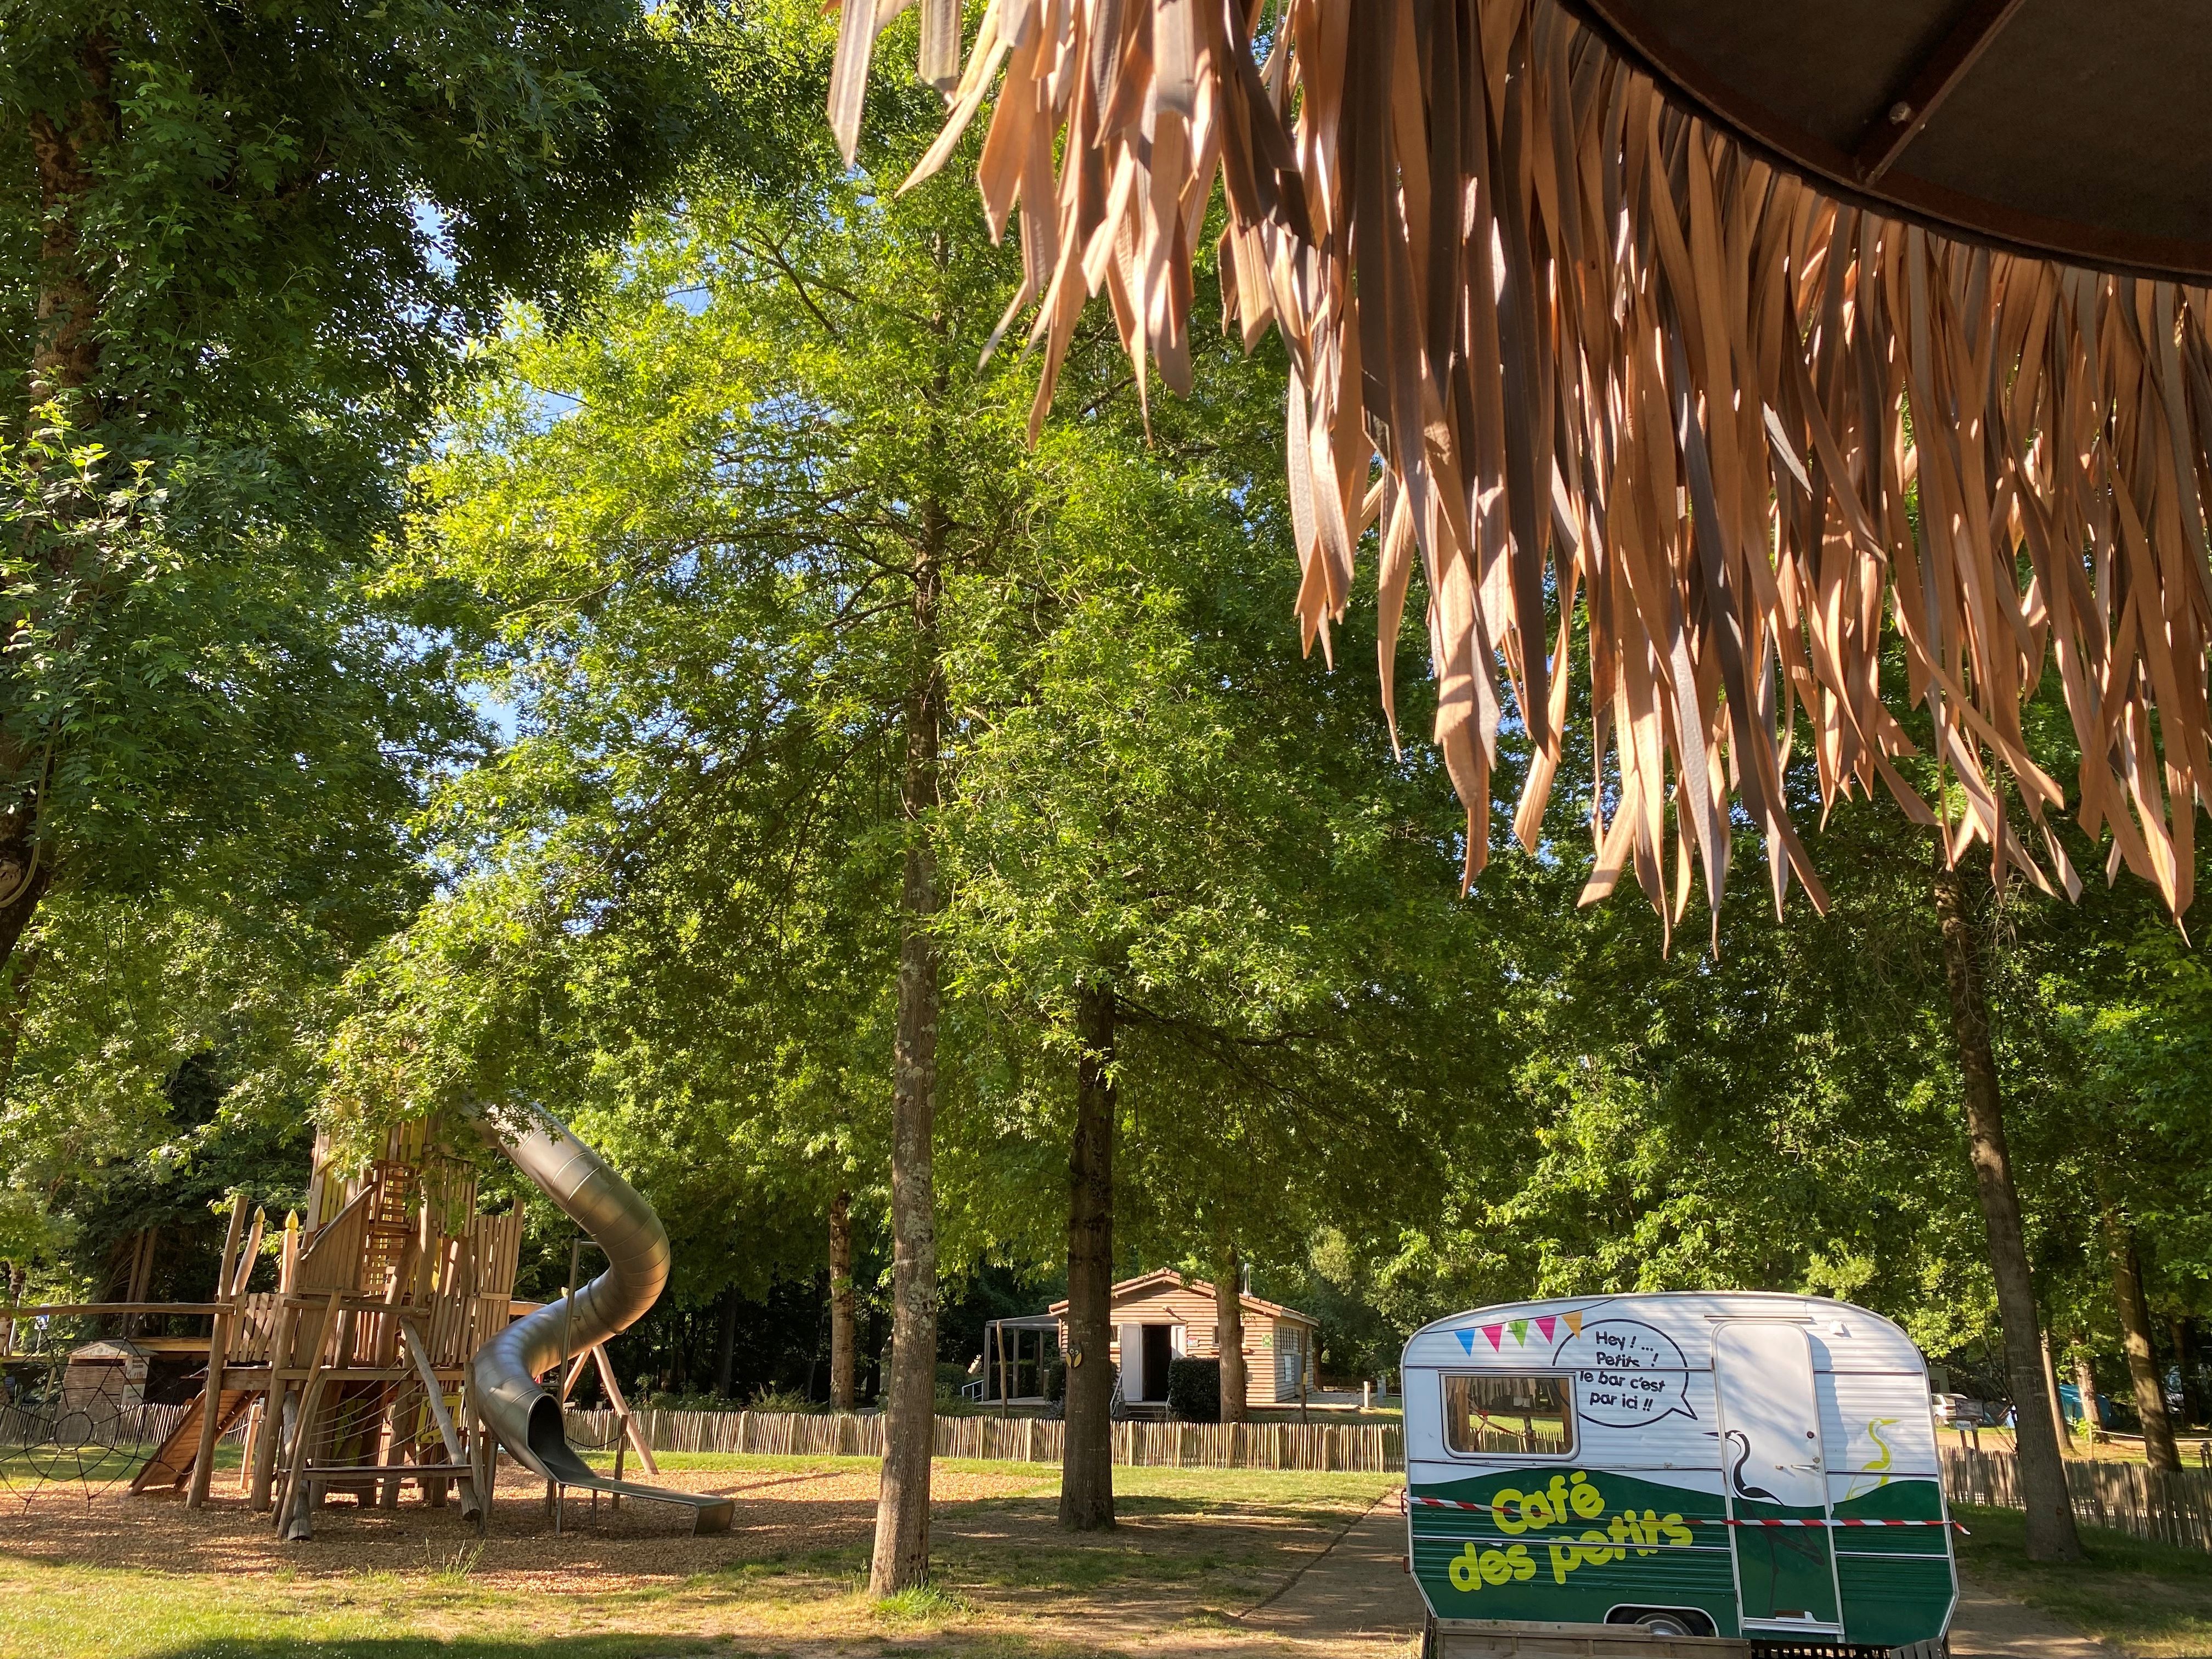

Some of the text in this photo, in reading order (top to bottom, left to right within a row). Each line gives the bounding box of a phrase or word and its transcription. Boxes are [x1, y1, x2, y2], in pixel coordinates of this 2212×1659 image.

[1596, 1331, 1625, 1350] Hey
[1630, 1336, 1637, 1348] !
[1596, 1352, 1658, 1367] Petits !
[1580, 1370, 1666, 1392] le bar c'est
[1590, 1392, 1617, 1406] par
[1622, 1393, 1638, 1409] ici
[1491, 1470, 1605, 1534] Café
[1448, 1509, 1694, 1592] des petits
